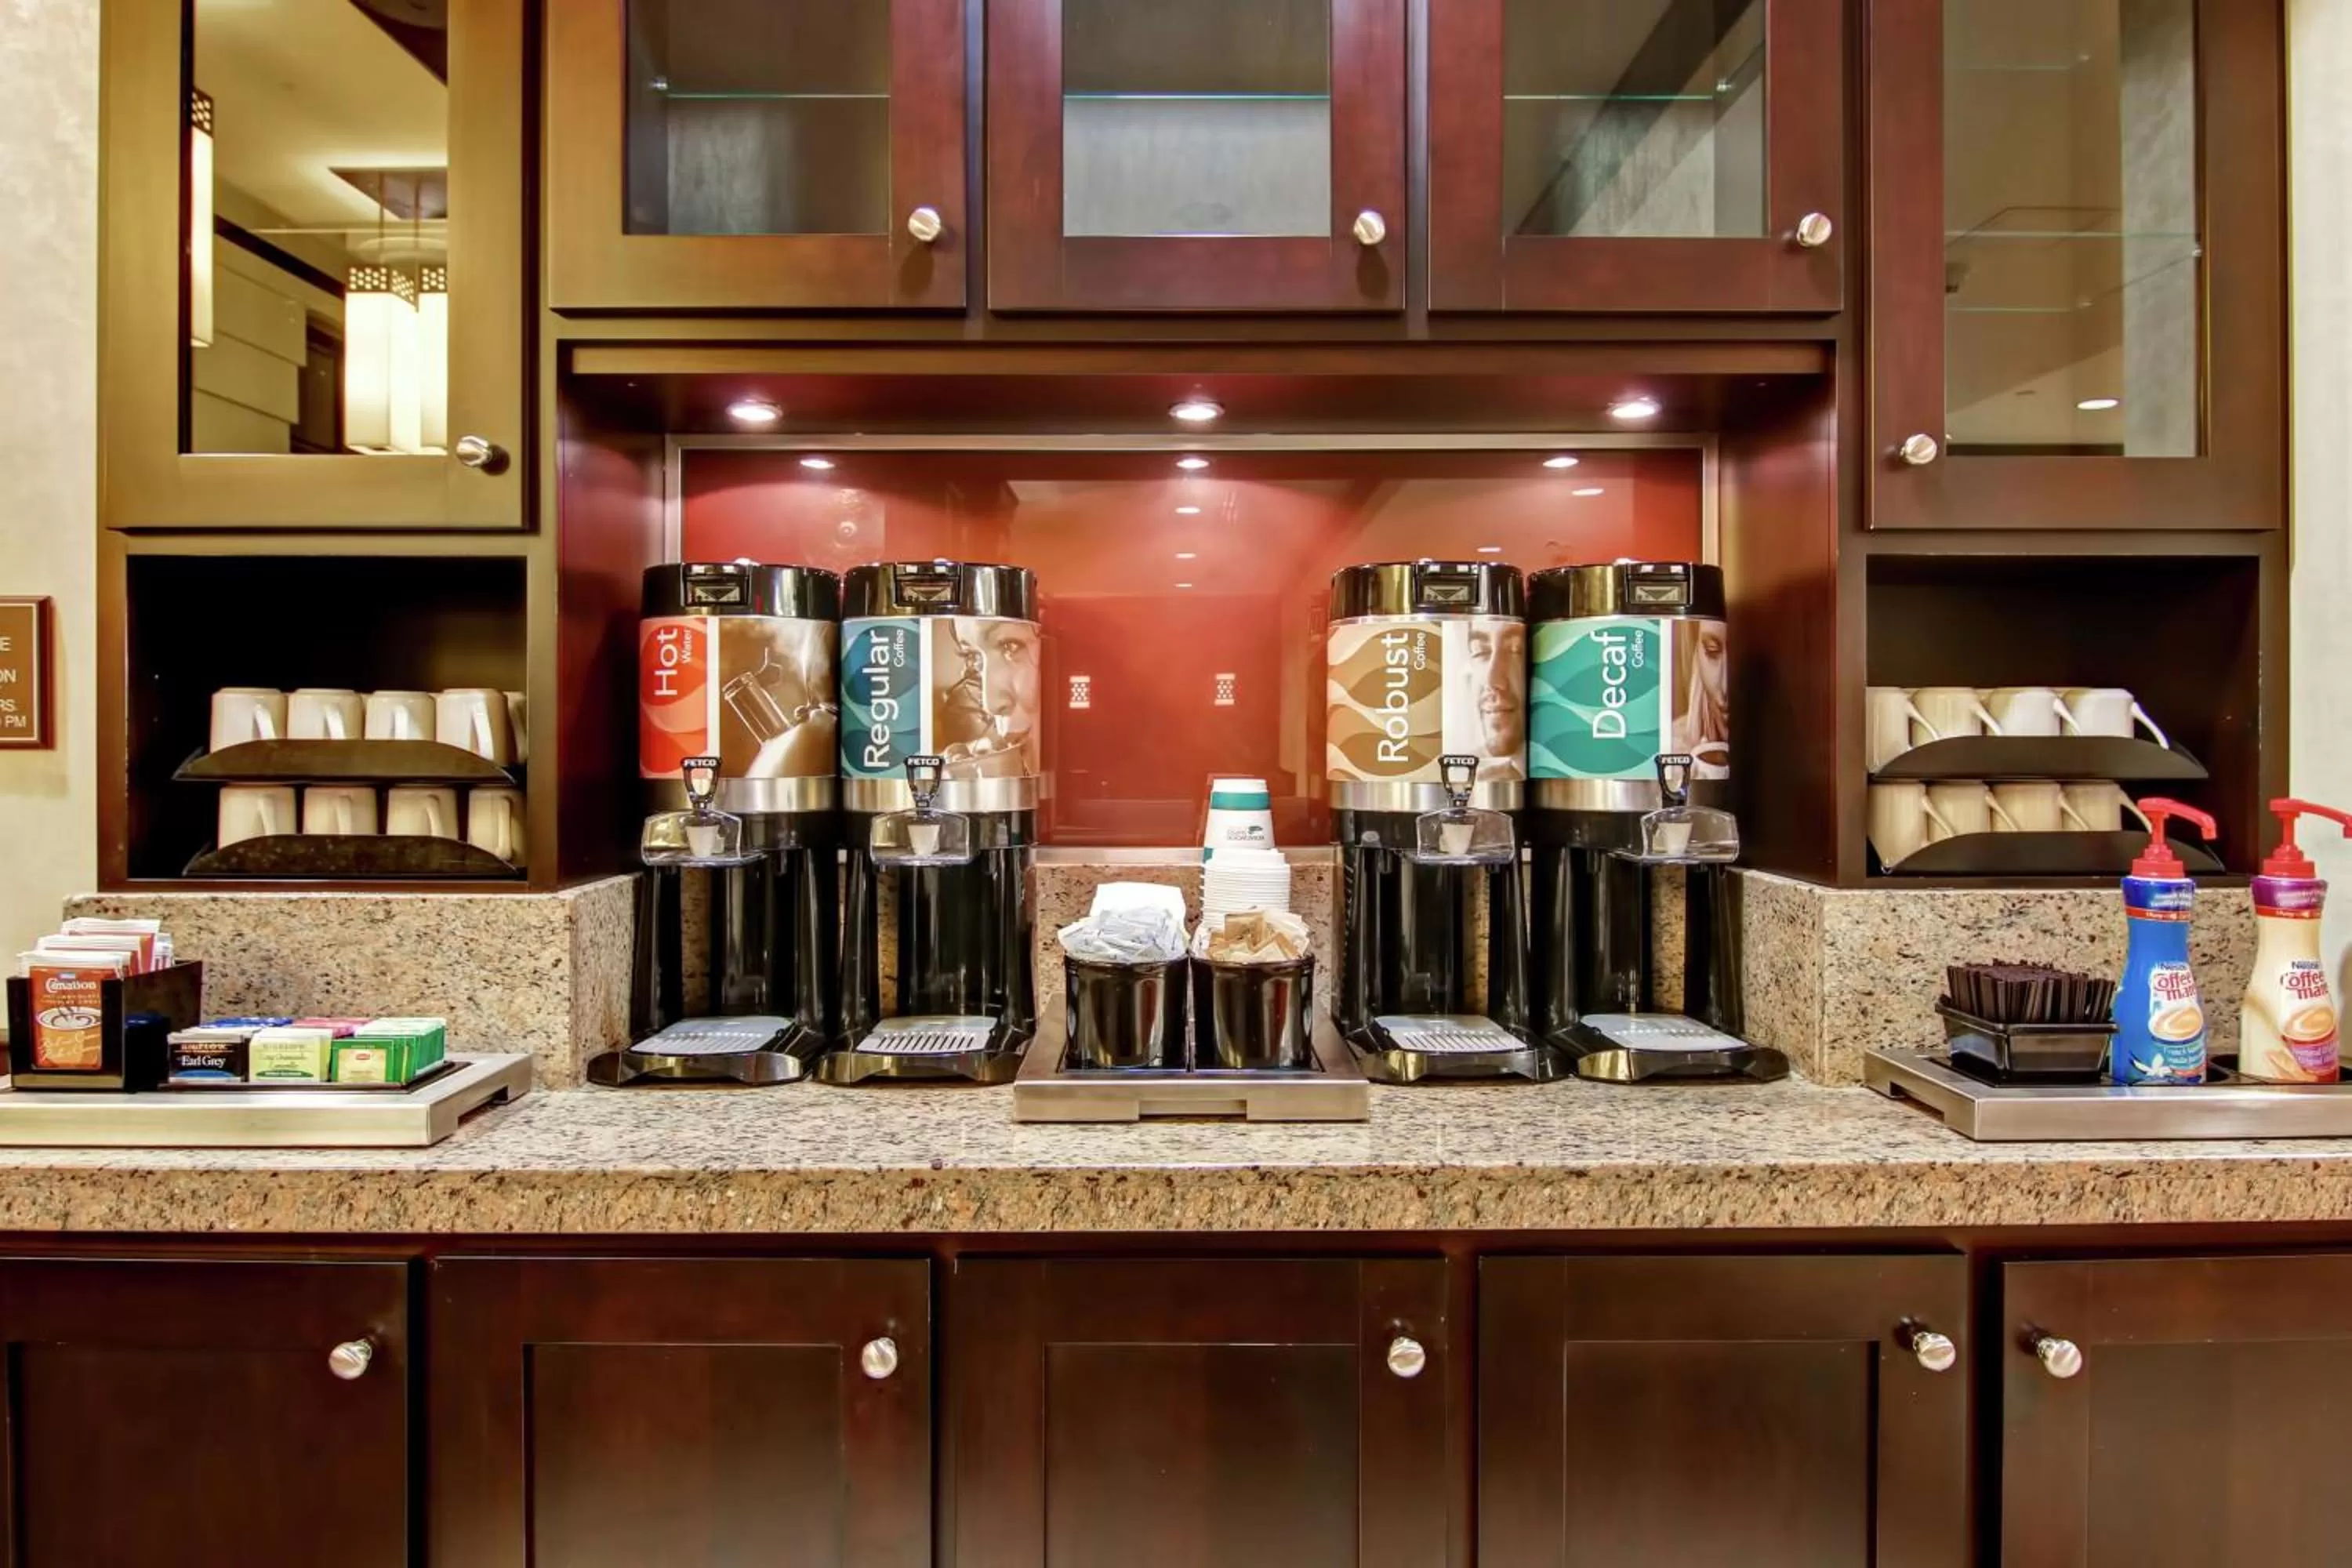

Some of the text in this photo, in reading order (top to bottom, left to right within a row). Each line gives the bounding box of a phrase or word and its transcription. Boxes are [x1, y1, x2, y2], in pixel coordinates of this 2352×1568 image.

[654, 628, 678, 695] Hot
[681, 628, 691, 664] Water
[893, 629, 904, 668] Coffee
[1414, 631, 1426, 670] Coffee
[1632, 630, 1643, 668] Coffee
[862, 630, 899, 768] Regular
[1376, 632, 1409, 762] Robust
[1590, 630, 1627, 739] Decaf
[5, 715, 27, 728] PM
[181, 1055, 227, 1069] Earl Grey
